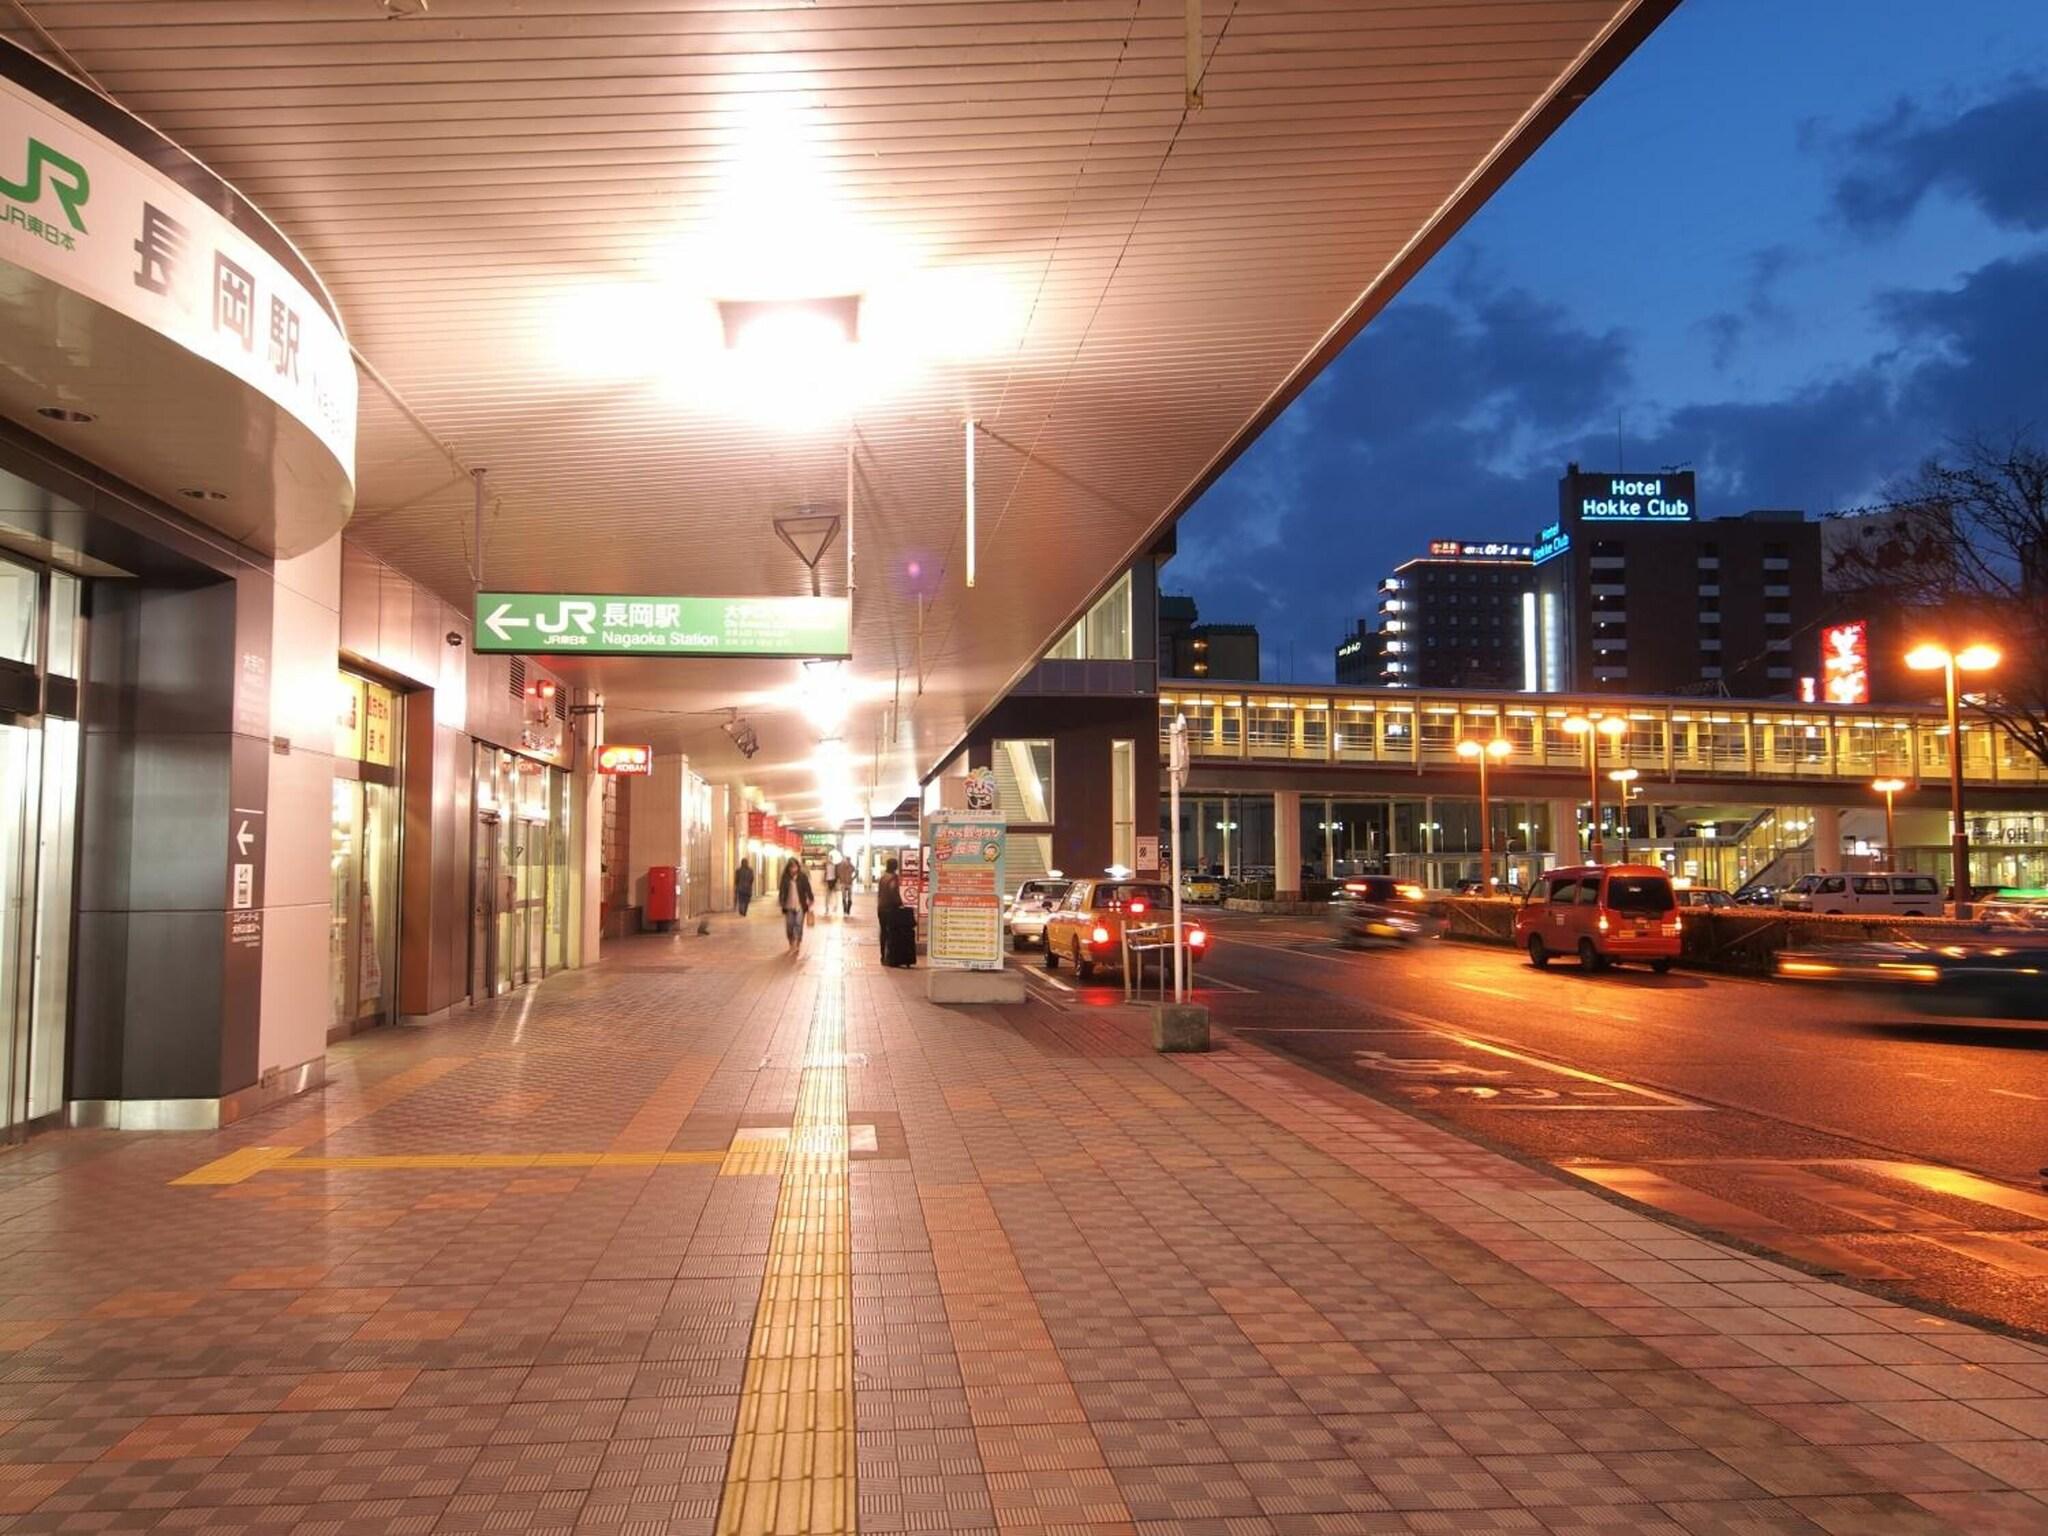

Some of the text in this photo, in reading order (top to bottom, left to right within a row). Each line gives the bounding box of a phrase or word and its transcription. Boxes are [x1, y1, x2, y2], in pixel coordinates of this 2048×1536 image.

[0, 137, 90, 236] JR
[133, 200, 301, 386] 長岡駅
[1611, 479, 1662, 496] Hotel
[1583, 498, 1689, 516] Hokke Club
[536, 600, 597, 634] JR
[602, 602, 682, 629] 長岡駅
[601, 630, 667, 649] Nagaoka
[669, 631, 720, 647] Station
[615, 763, 647, 773] KOBAN
